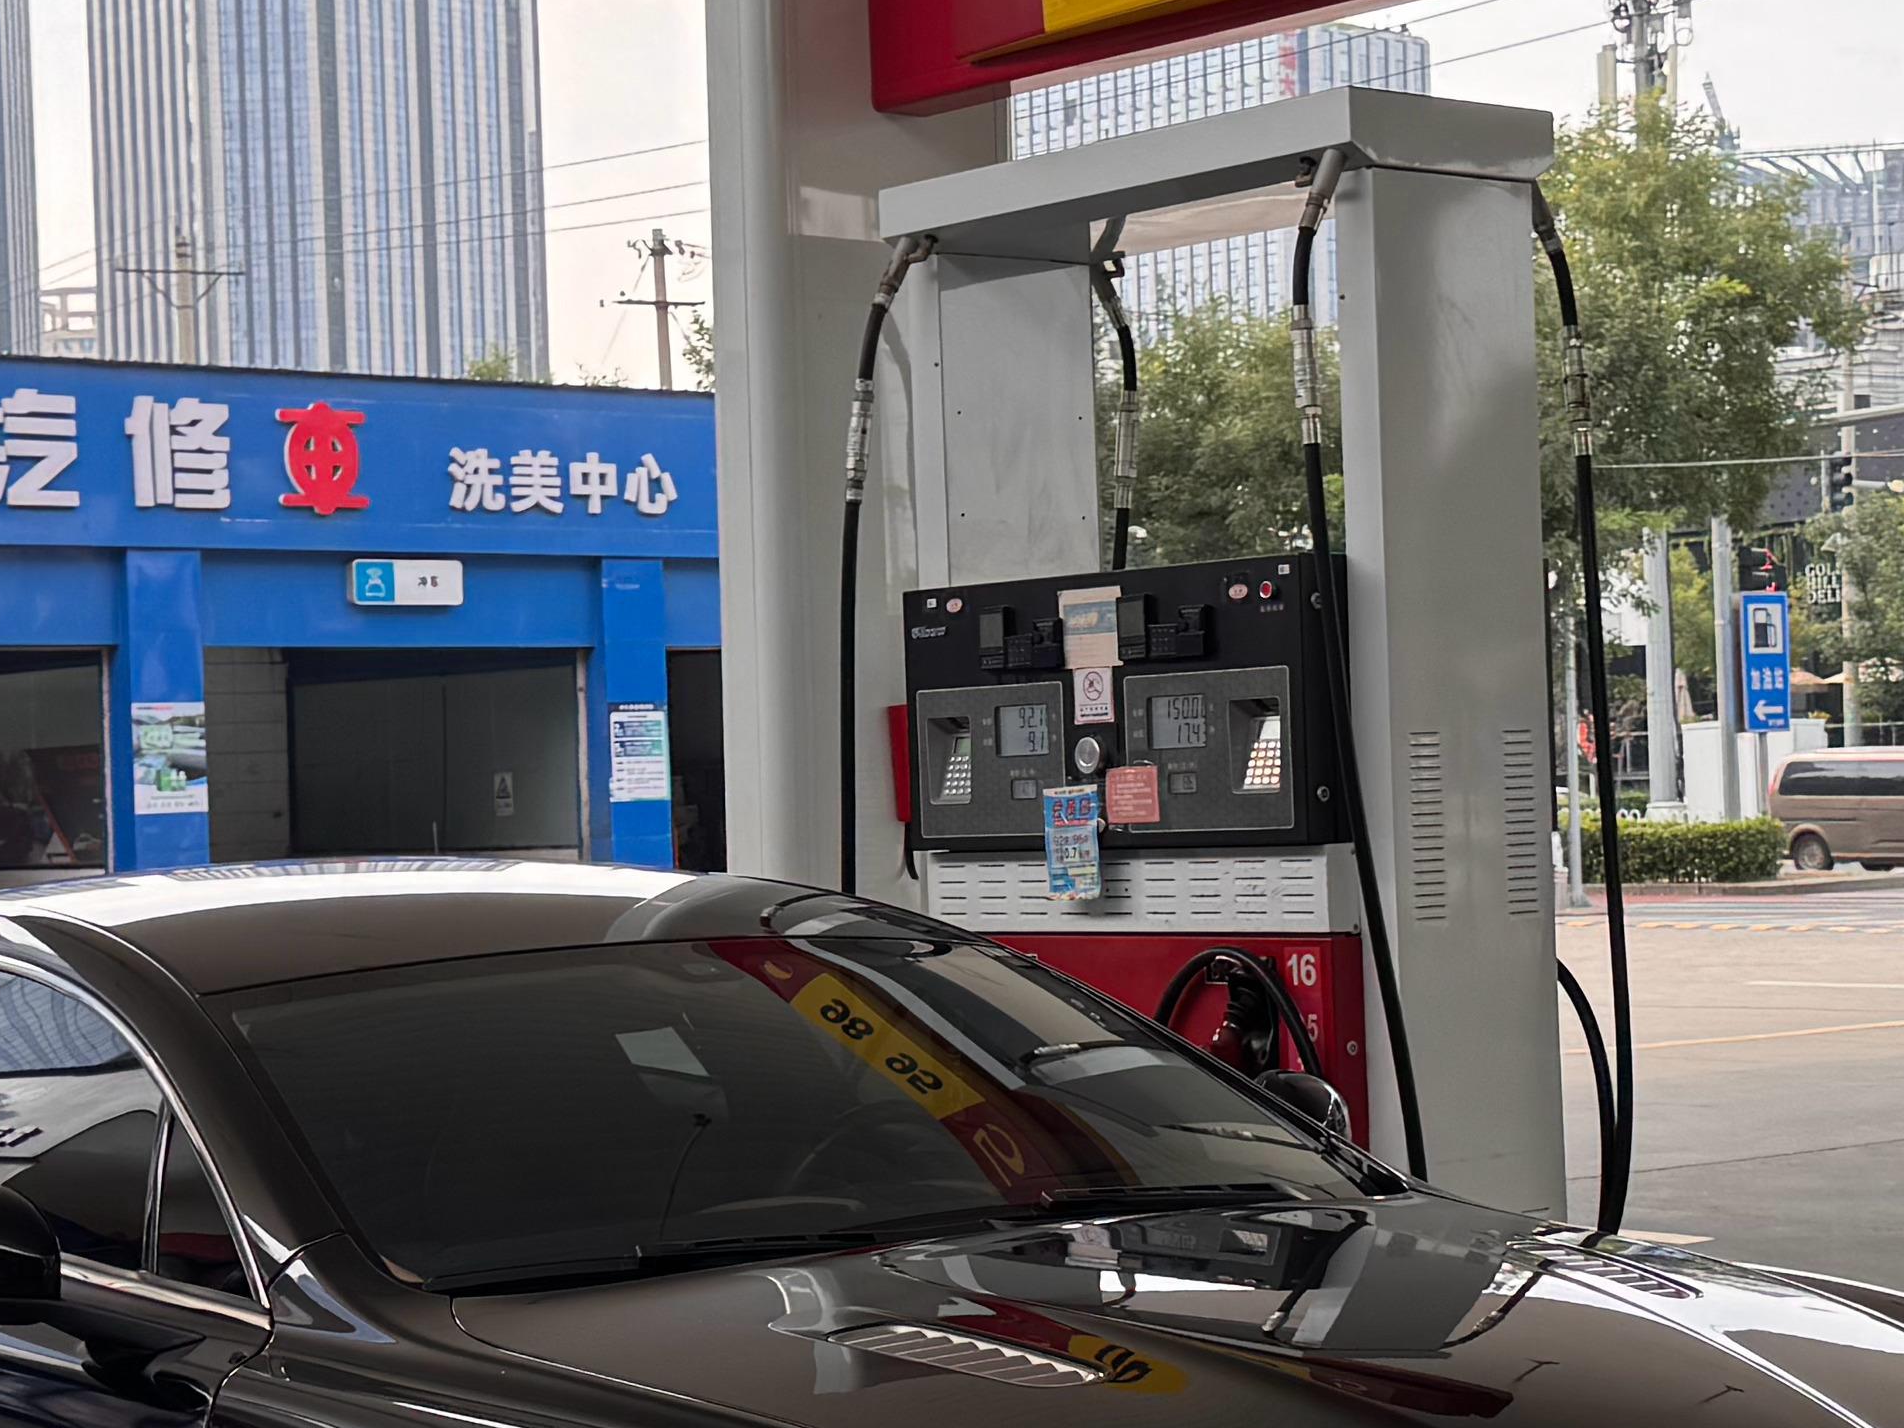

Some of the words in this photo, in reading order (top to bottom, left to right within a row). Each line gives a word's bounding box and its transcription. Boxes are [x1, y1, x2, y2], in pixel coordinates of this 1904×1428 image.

[448, 446, 678, 516] 洗美中心
[1286, 953, 1317, 987] 16
